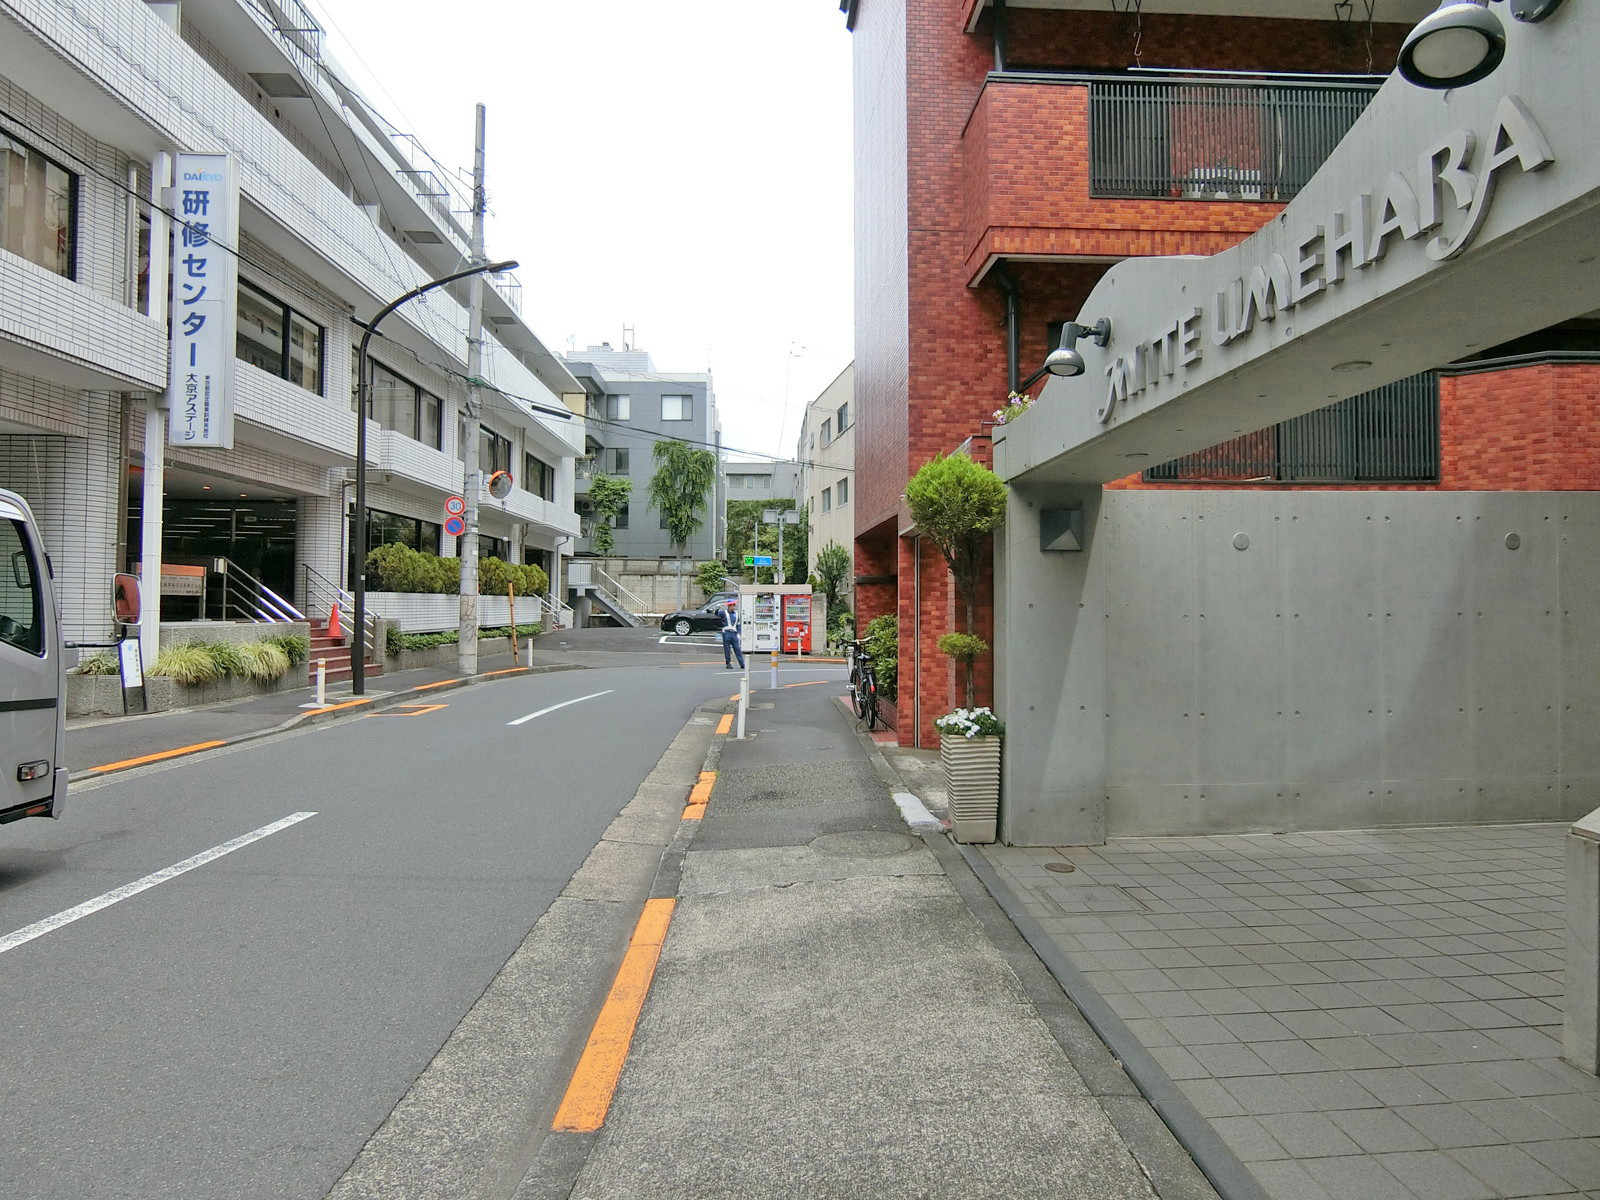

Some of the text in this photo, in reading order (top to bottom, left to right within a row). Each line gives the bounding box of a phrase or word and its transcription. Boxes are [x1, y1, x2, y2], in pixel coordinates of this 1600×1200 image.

[184, 172, 223, 182] DAIKYO
[1209, 94, 1556, 347] UMEHARA
[182, 189, 210, 367] 研修センター
[184, 373, 198, 441] 大京アステージ
[450, 501, 462, 511] 30
